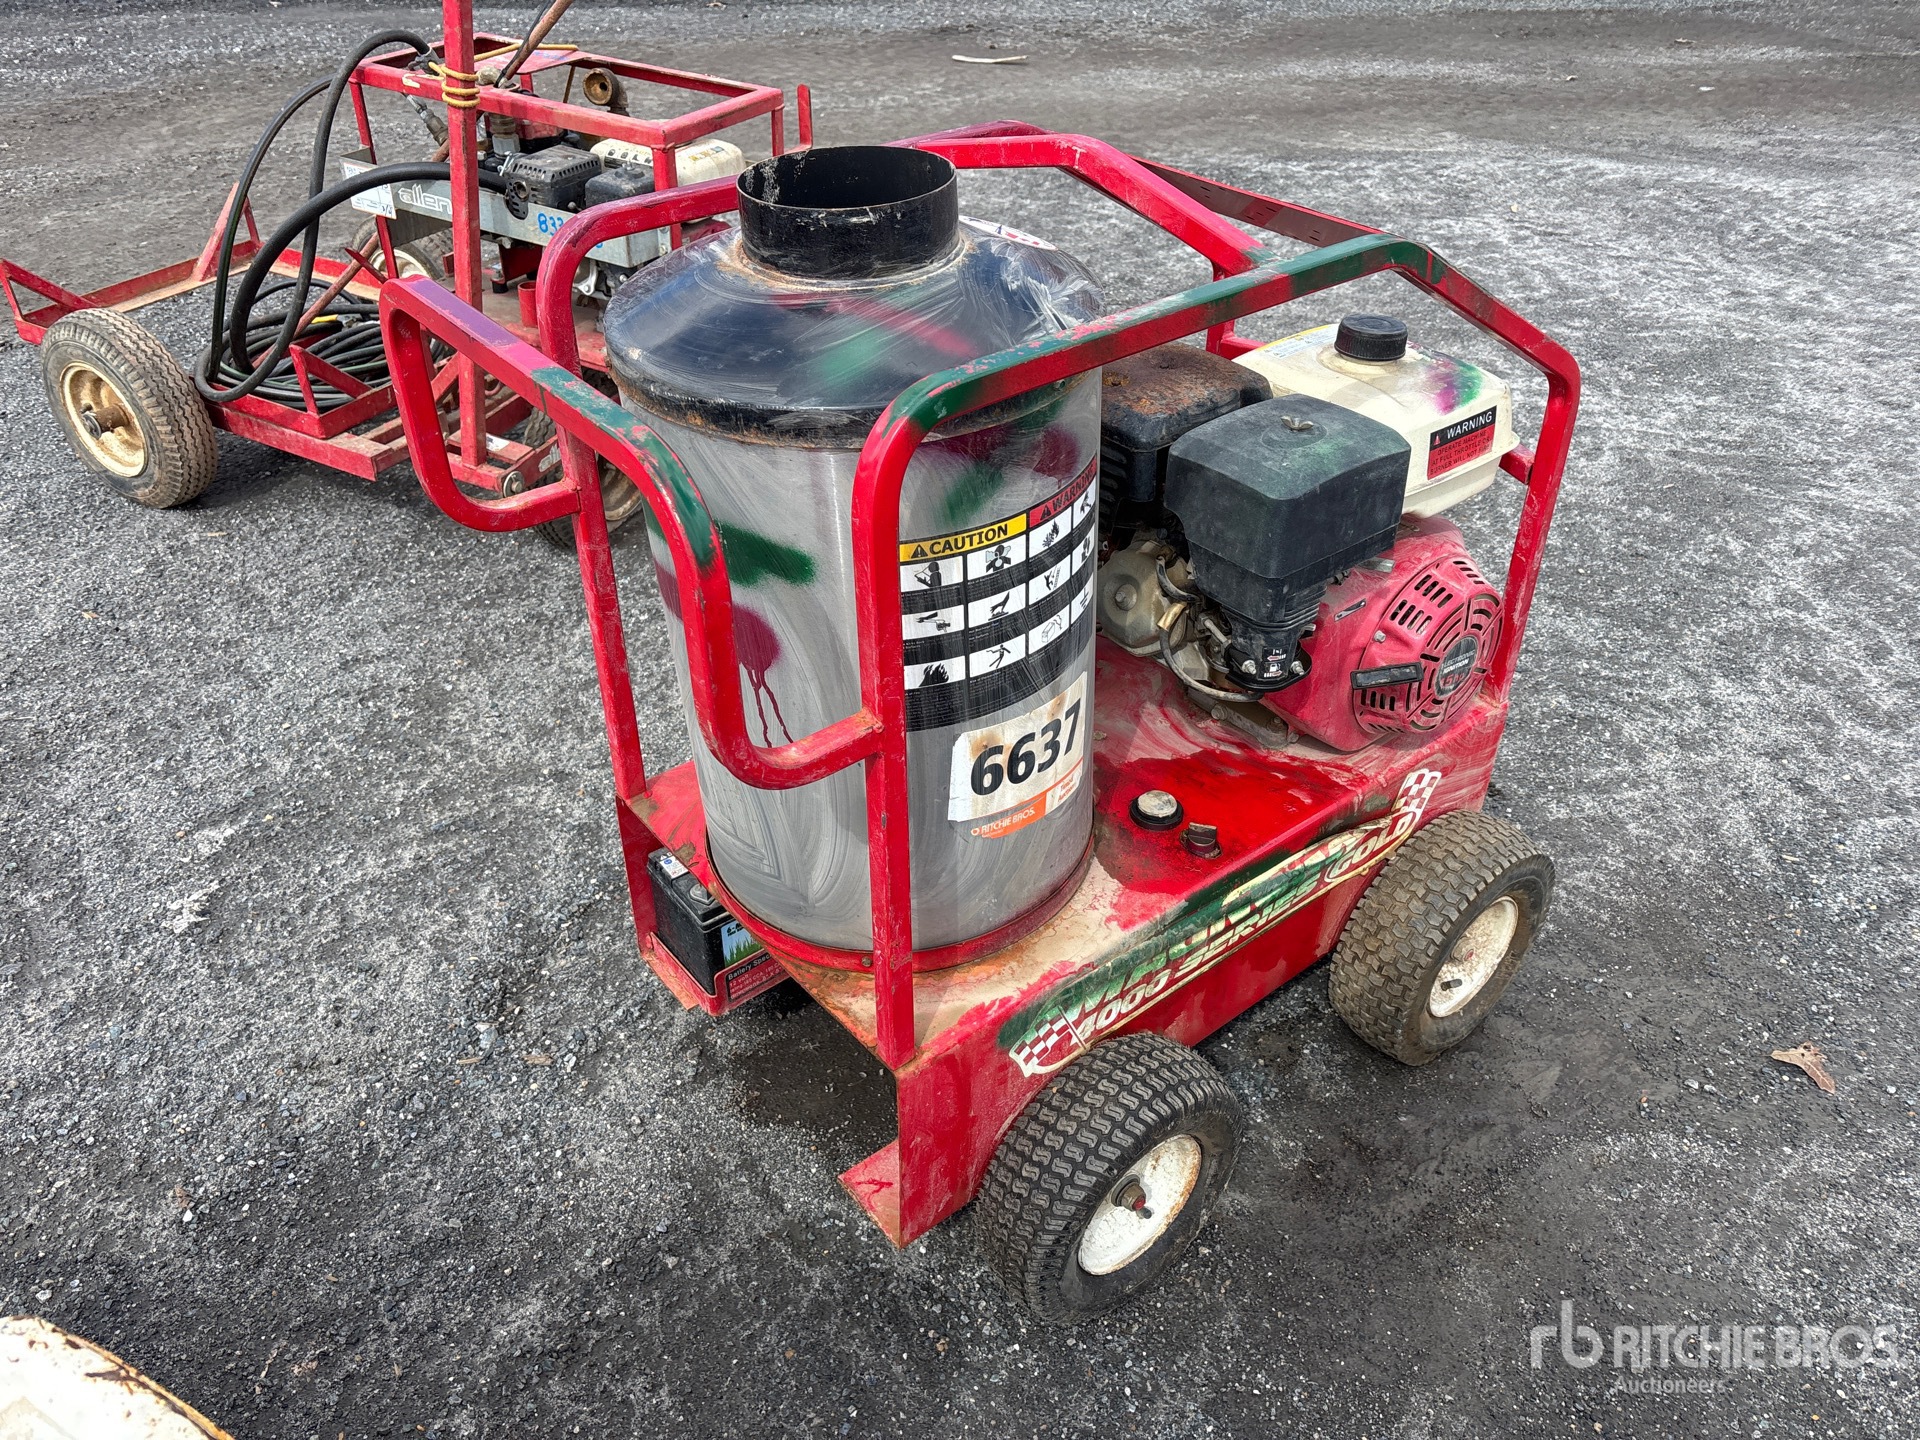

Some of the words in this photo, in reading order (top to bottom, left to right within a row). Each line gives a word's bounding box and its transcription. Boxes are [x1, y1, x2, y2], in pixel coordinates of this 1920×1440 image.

[398, 183, 453, 214] allen
[1446, 411, 1493, 440] WARNING
[1437, 442, 1462, 456] OPERATE
[1462, 430, 1487, 444] MACHINE
[1440, 453, 1453, 463] FULL
[1454, 441, 1481, 456] THROTTLE
[1454, 456, 1466, 465] WILL
[1467, 450, 1477, 458] NOT
[929, 523, 1009, 556] CAUTION
[970, 697, 1081, 796] 6637
[981, 816, 1012, 834] RITCHIE
[1329, 812, 1415, 878] GOLD
[728, 964, 752, 980] Battery
[752, 953, 771, 967] Spec
[1071, 968, 1172, 1045] 4000
[1173, 871, 1322, 979] SERIES
